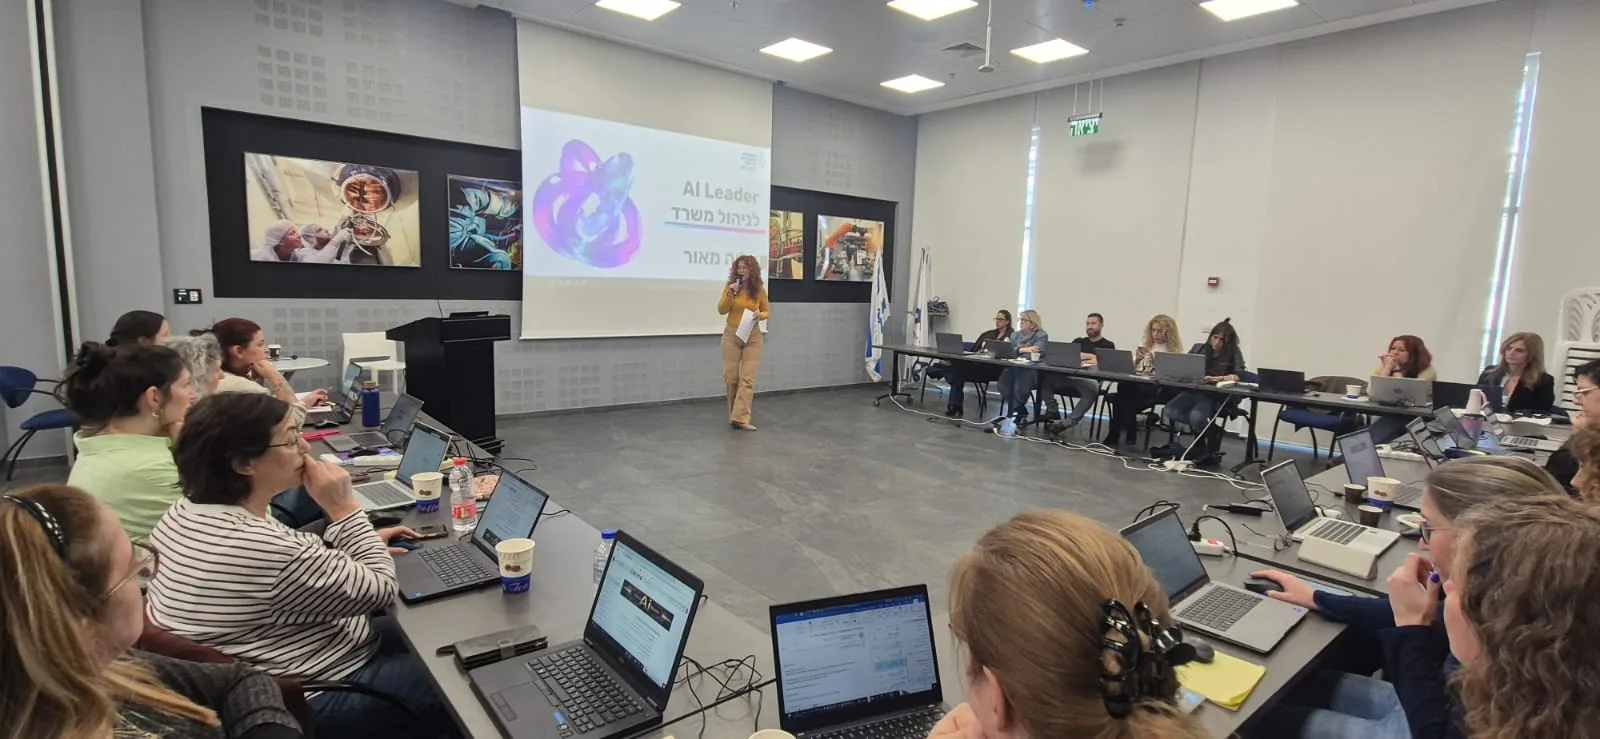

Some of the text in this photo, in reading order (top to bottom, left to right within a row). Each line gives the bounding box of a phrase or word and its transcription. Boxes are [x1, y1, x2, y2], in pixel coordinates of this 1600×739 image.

[1070, 117, 1099, 136] יציאה
[683, 180, 760, 204] AI Leader
[671, 206, 760, 227] לניהול משרד
[683, 250, 720, 265] מאור
